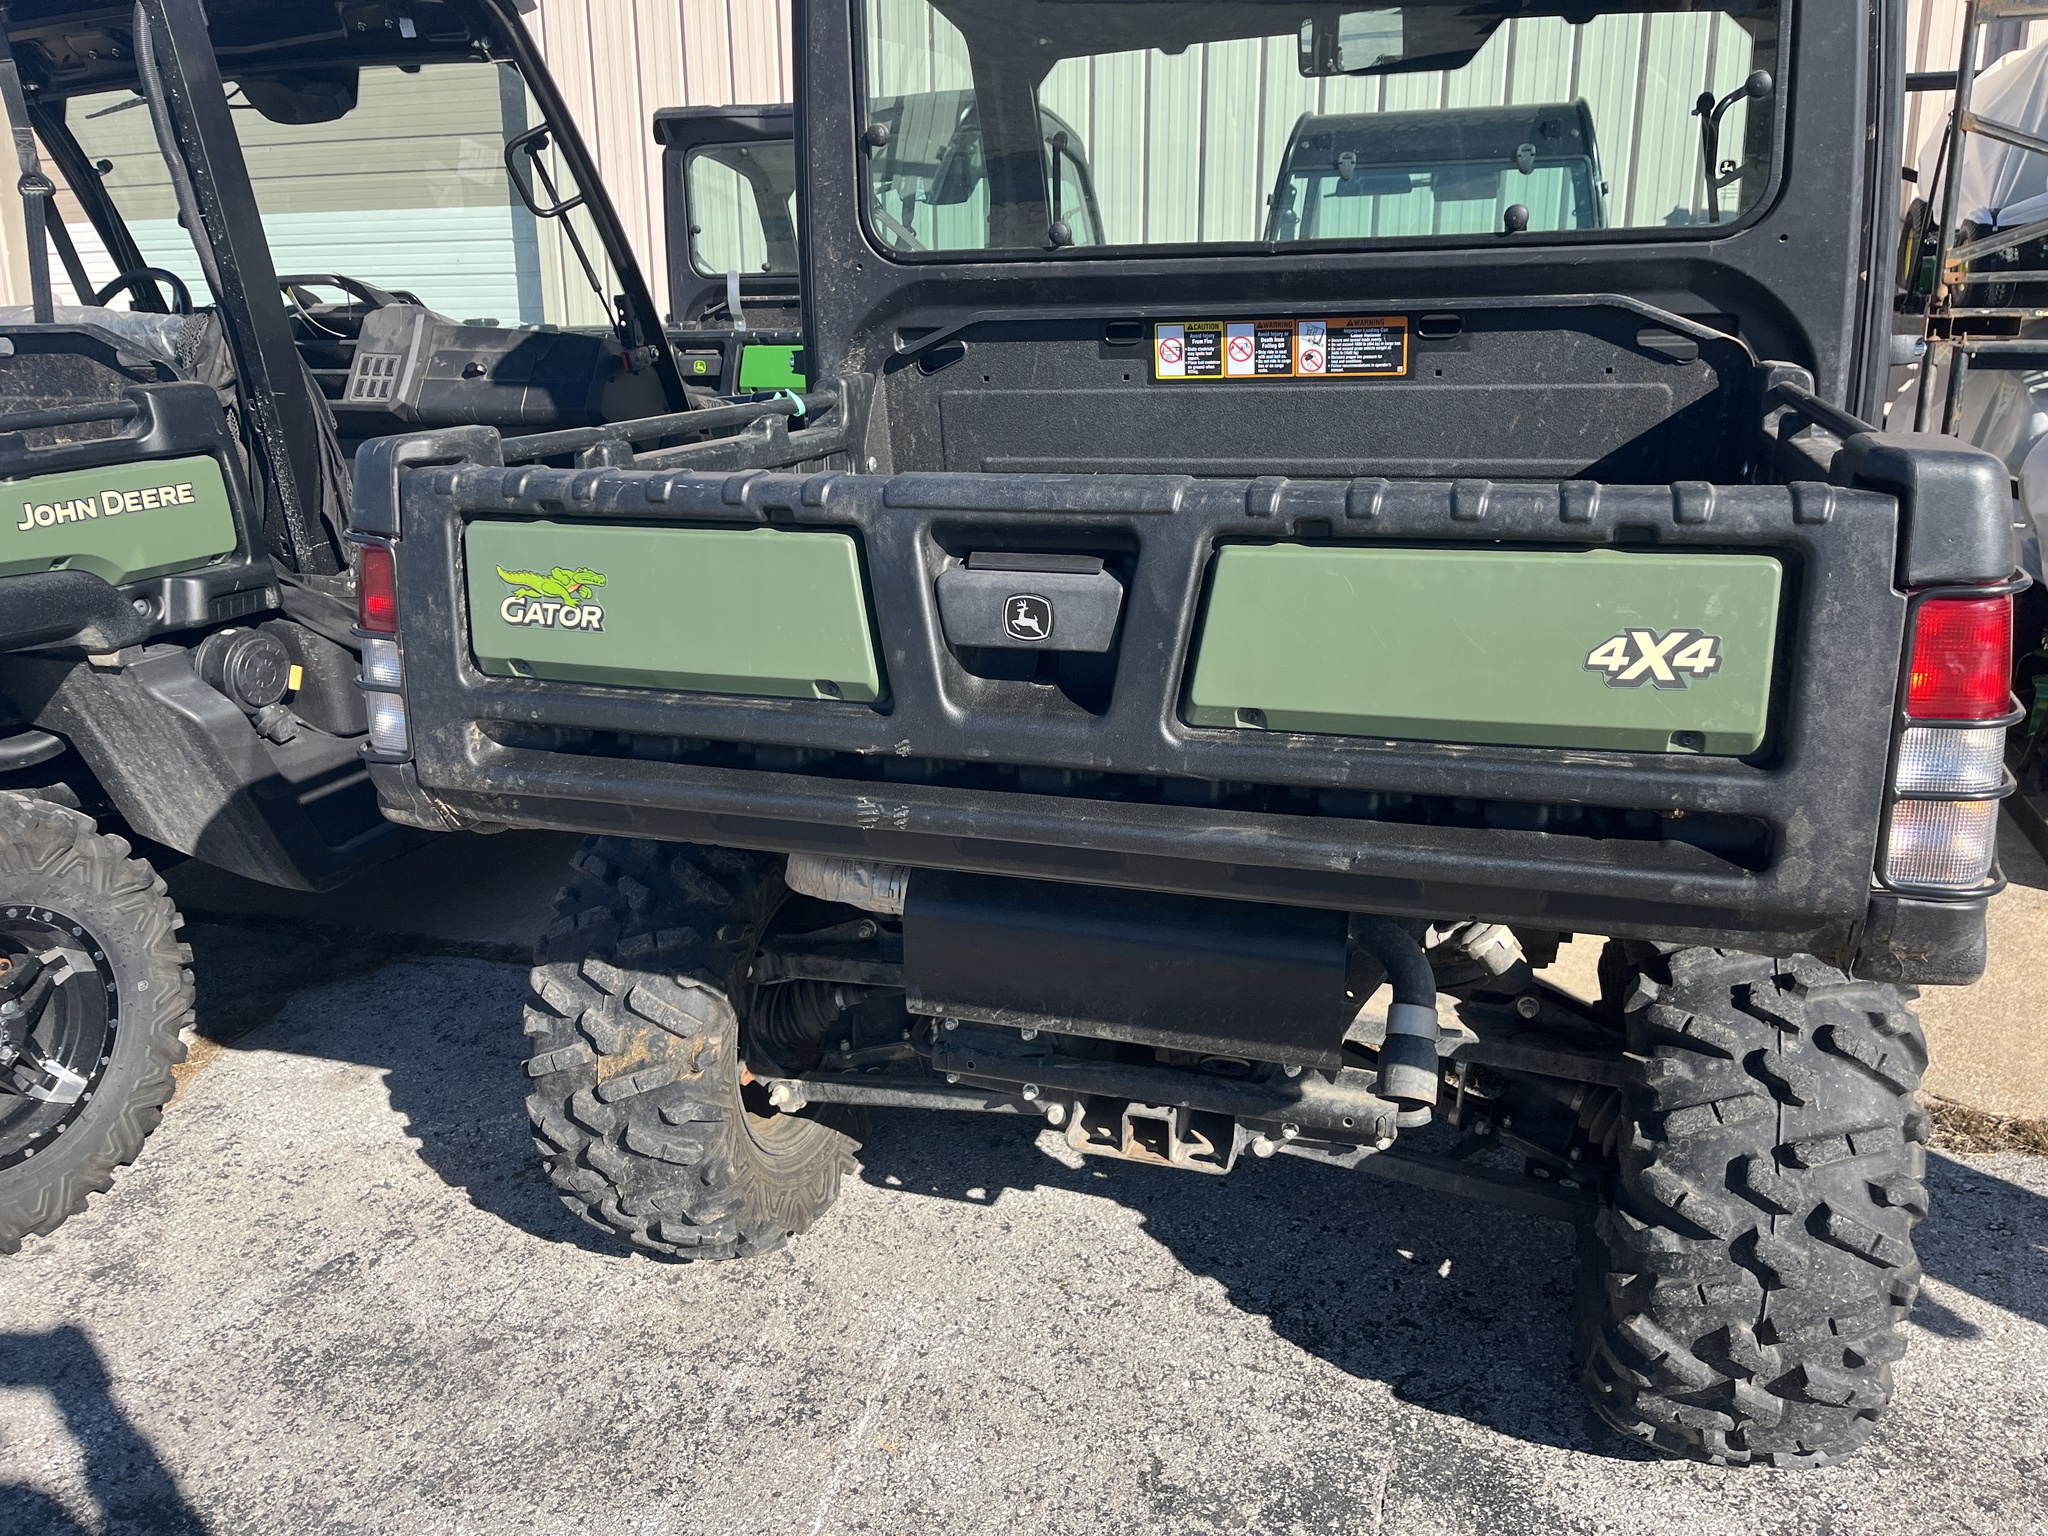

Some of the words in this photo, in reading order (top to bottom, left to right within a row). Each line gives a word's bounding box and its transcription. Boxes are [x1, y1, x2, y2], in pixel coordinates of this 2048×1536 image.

[17, 497, 98, 531] JOHN
[99, 482, 195, 517] DEERE
[500, 596, 604, 632] GATOR
[1585, 629, 1720, 685] 4X4
